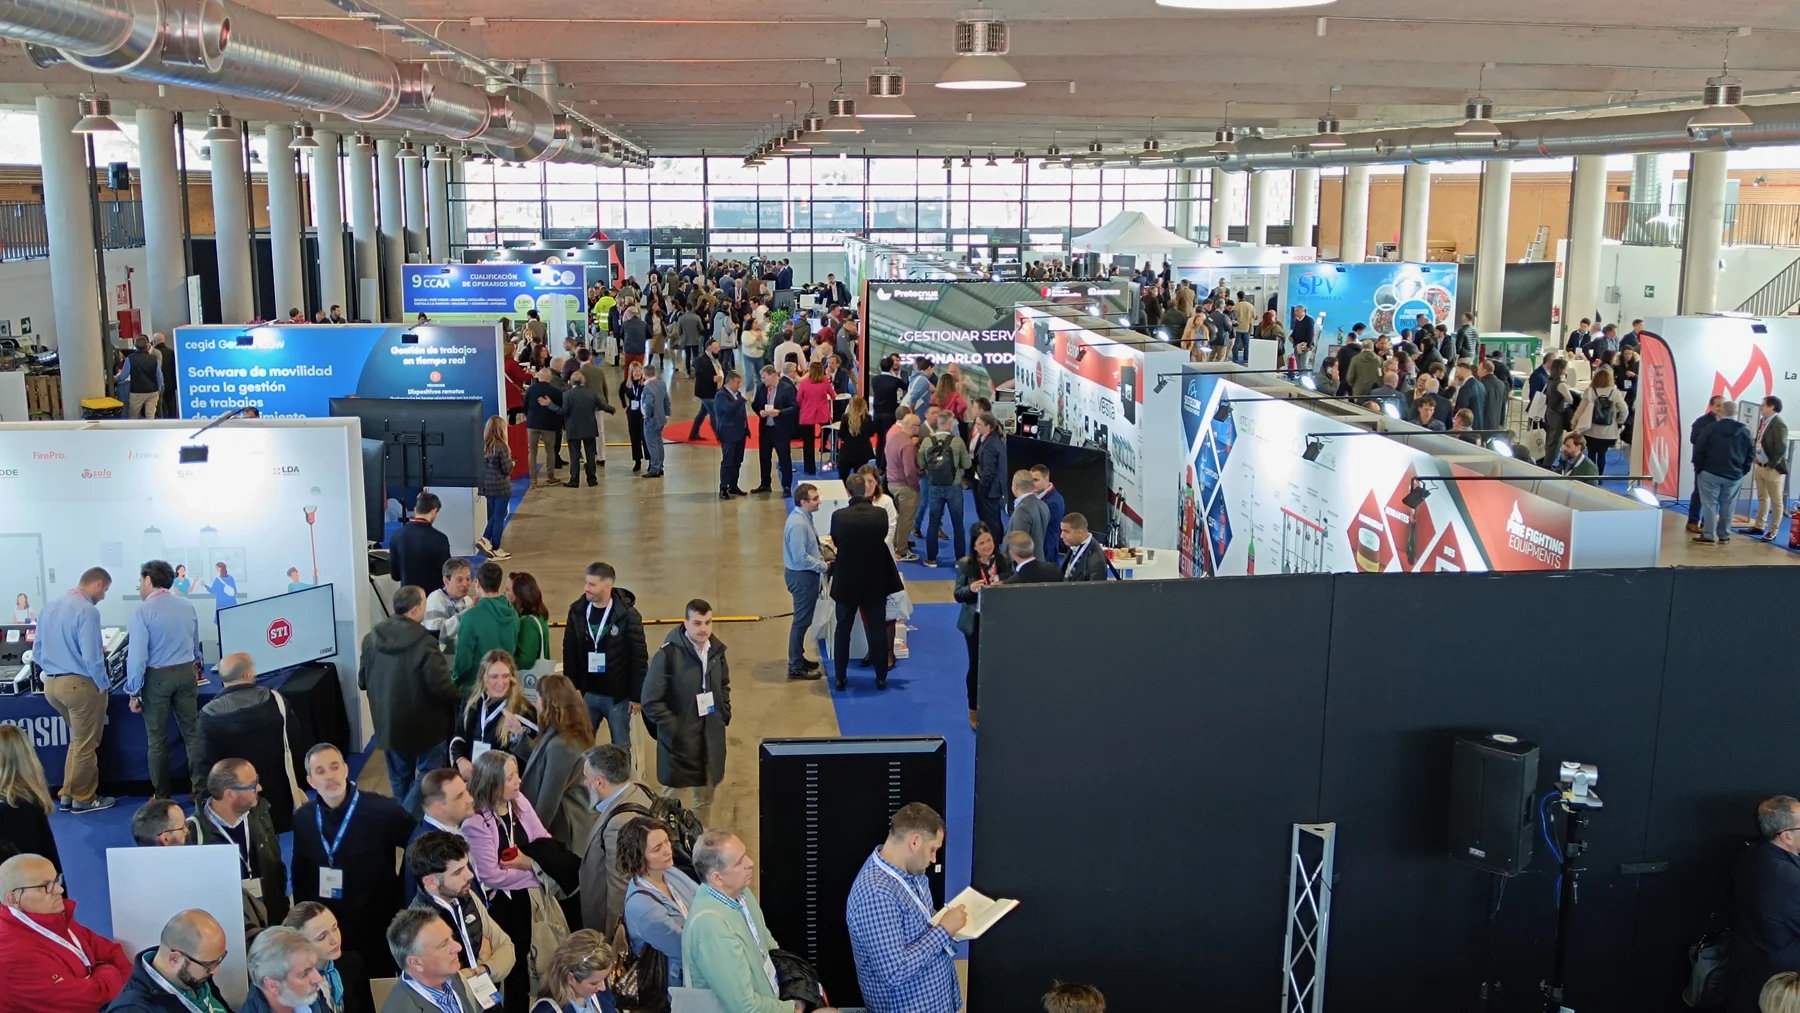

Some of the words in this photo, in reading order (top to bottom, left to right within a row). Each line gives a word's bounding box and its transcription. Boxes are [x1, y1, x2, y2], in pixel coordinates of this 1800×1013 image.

[411, 274, 422, 288] 9
[423, 279, 451, 288] CCAA
[1297, 275, 1338, 295] SPV
[897, 330, 980, 344] ¿GESTIONAR
[185, 340, 216, 352] cegid
[390, 345, 425, 355] Gestión
[426, 345, 439, 355] de
[440, 345, 477, 356] trabajos
[415, 356, 447, 367] tiempo
[448, 356, 466, 365] real
[984, 352, 1016, 365] TOD
[187, 365, 248, 378] Software
[250, 365, 267, 377] de
[269, 364, 333, 377] movilidad
[1784, 371, 1798, 380] La
[189, 382, 221, 396] para
[223, 381, 236, 393] la
[238, 381, 286, 395] gestión
[190, 397, 208, 408] de
[210, 397, 264, 410] trabajos
[93, 468, 112, 477] solo
[1525, 526, 1565, 555] FIGHTING
[1508, 534, 1562, 569] EQUIPMENTS
[270, 625, 289, 640] STI
